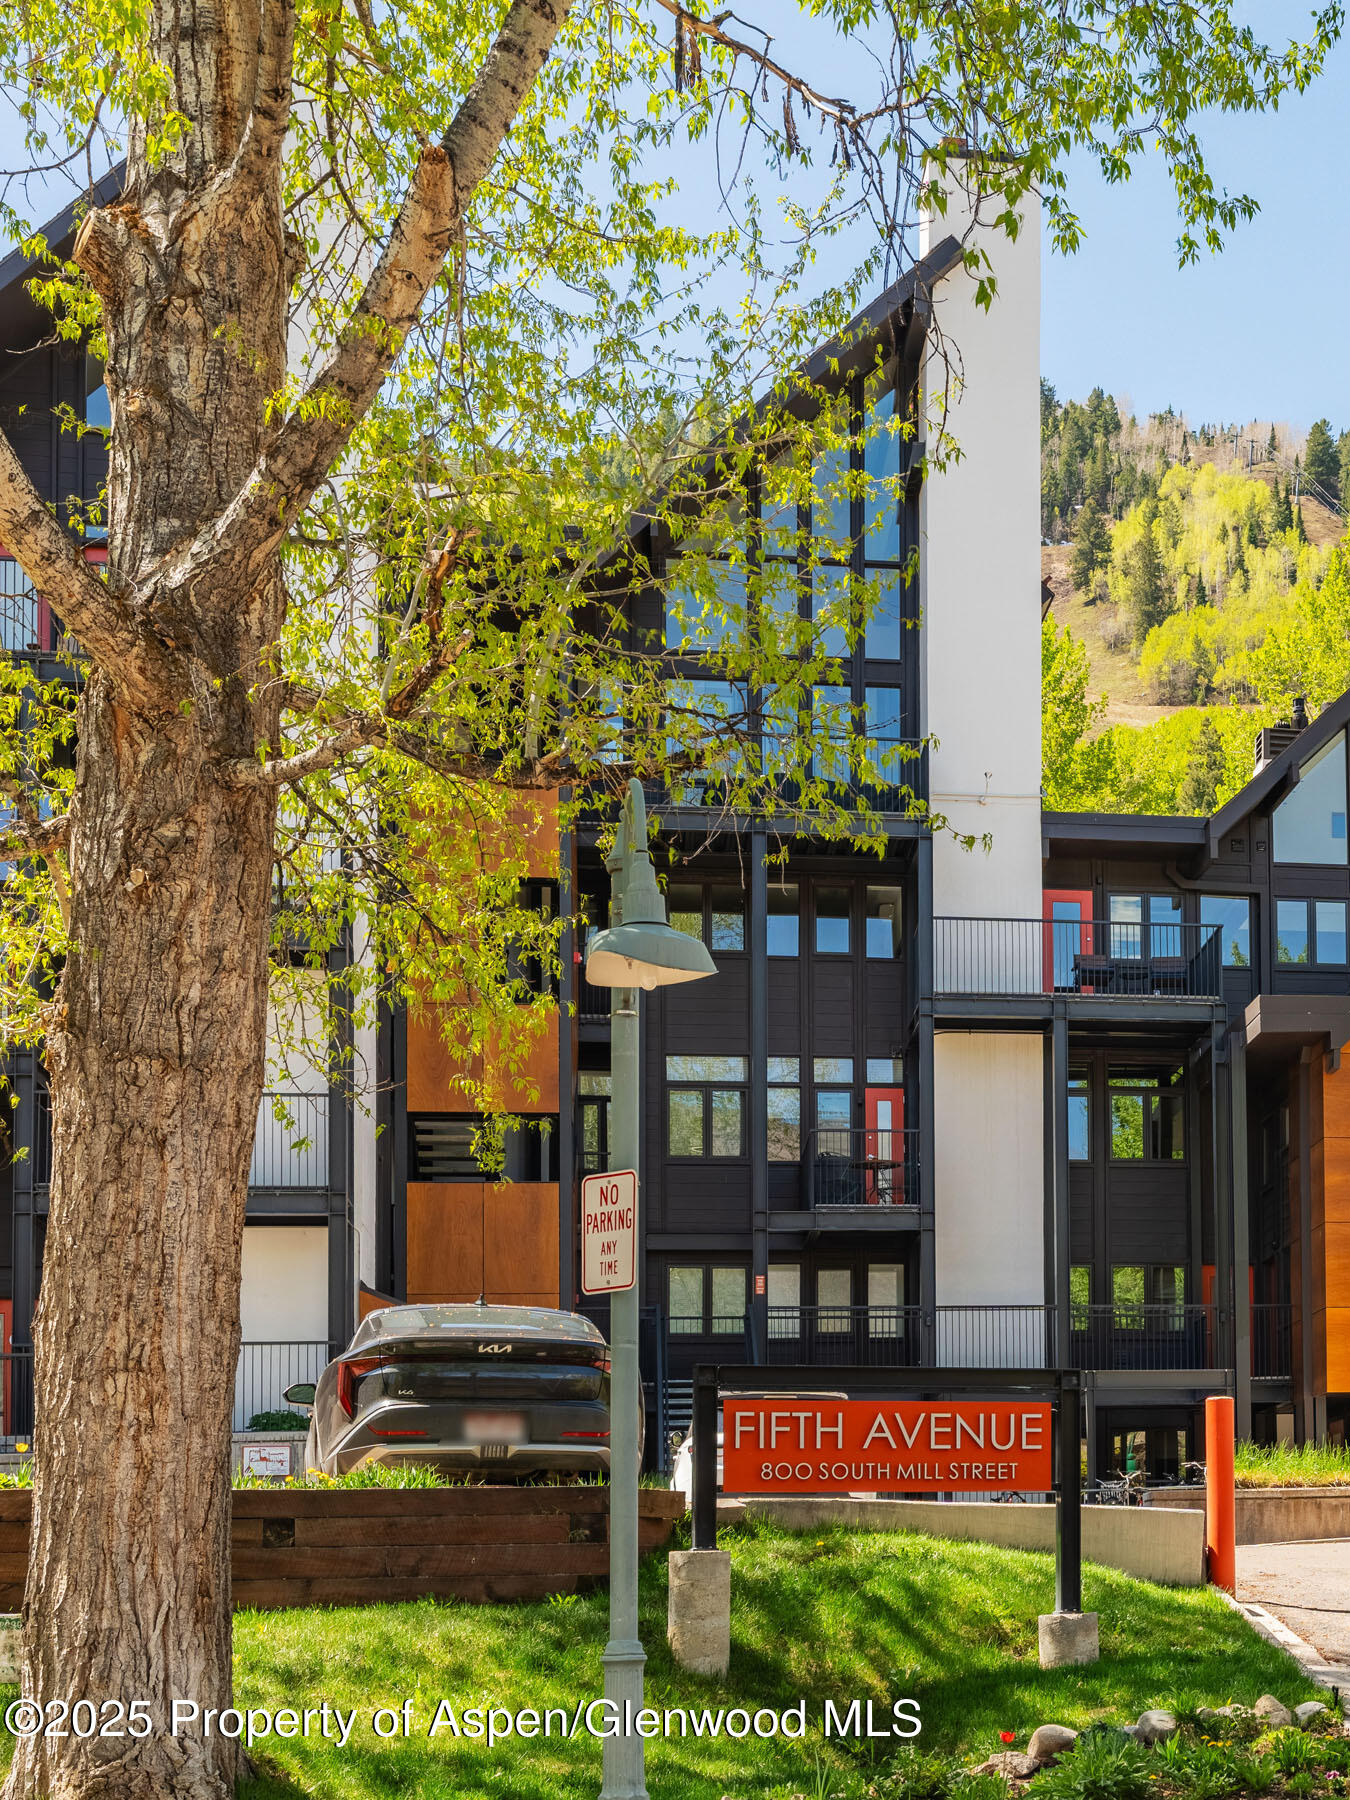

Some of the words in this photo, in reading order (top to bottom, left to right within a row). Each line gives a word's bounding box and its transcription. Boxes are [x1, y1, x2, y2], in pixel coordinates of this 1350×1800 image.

[600, 1183, 619, 1207] NO
[586, 1207, 632, 1235] PARKING
[600, 1240, 618, 1256] ANY
[599, 1260, 618, 1276] TIME
[734, 1411, 844, 1450] FIFTH
[862, 1411, 1044, 1451] AVENUE
[760, 1461, 813, 1480] 800
[818, 1461, 891, 1480] SOUTH
[896, 1461, 944, 1480] MILL
[949, 1461, 1019, 1480] STREET
